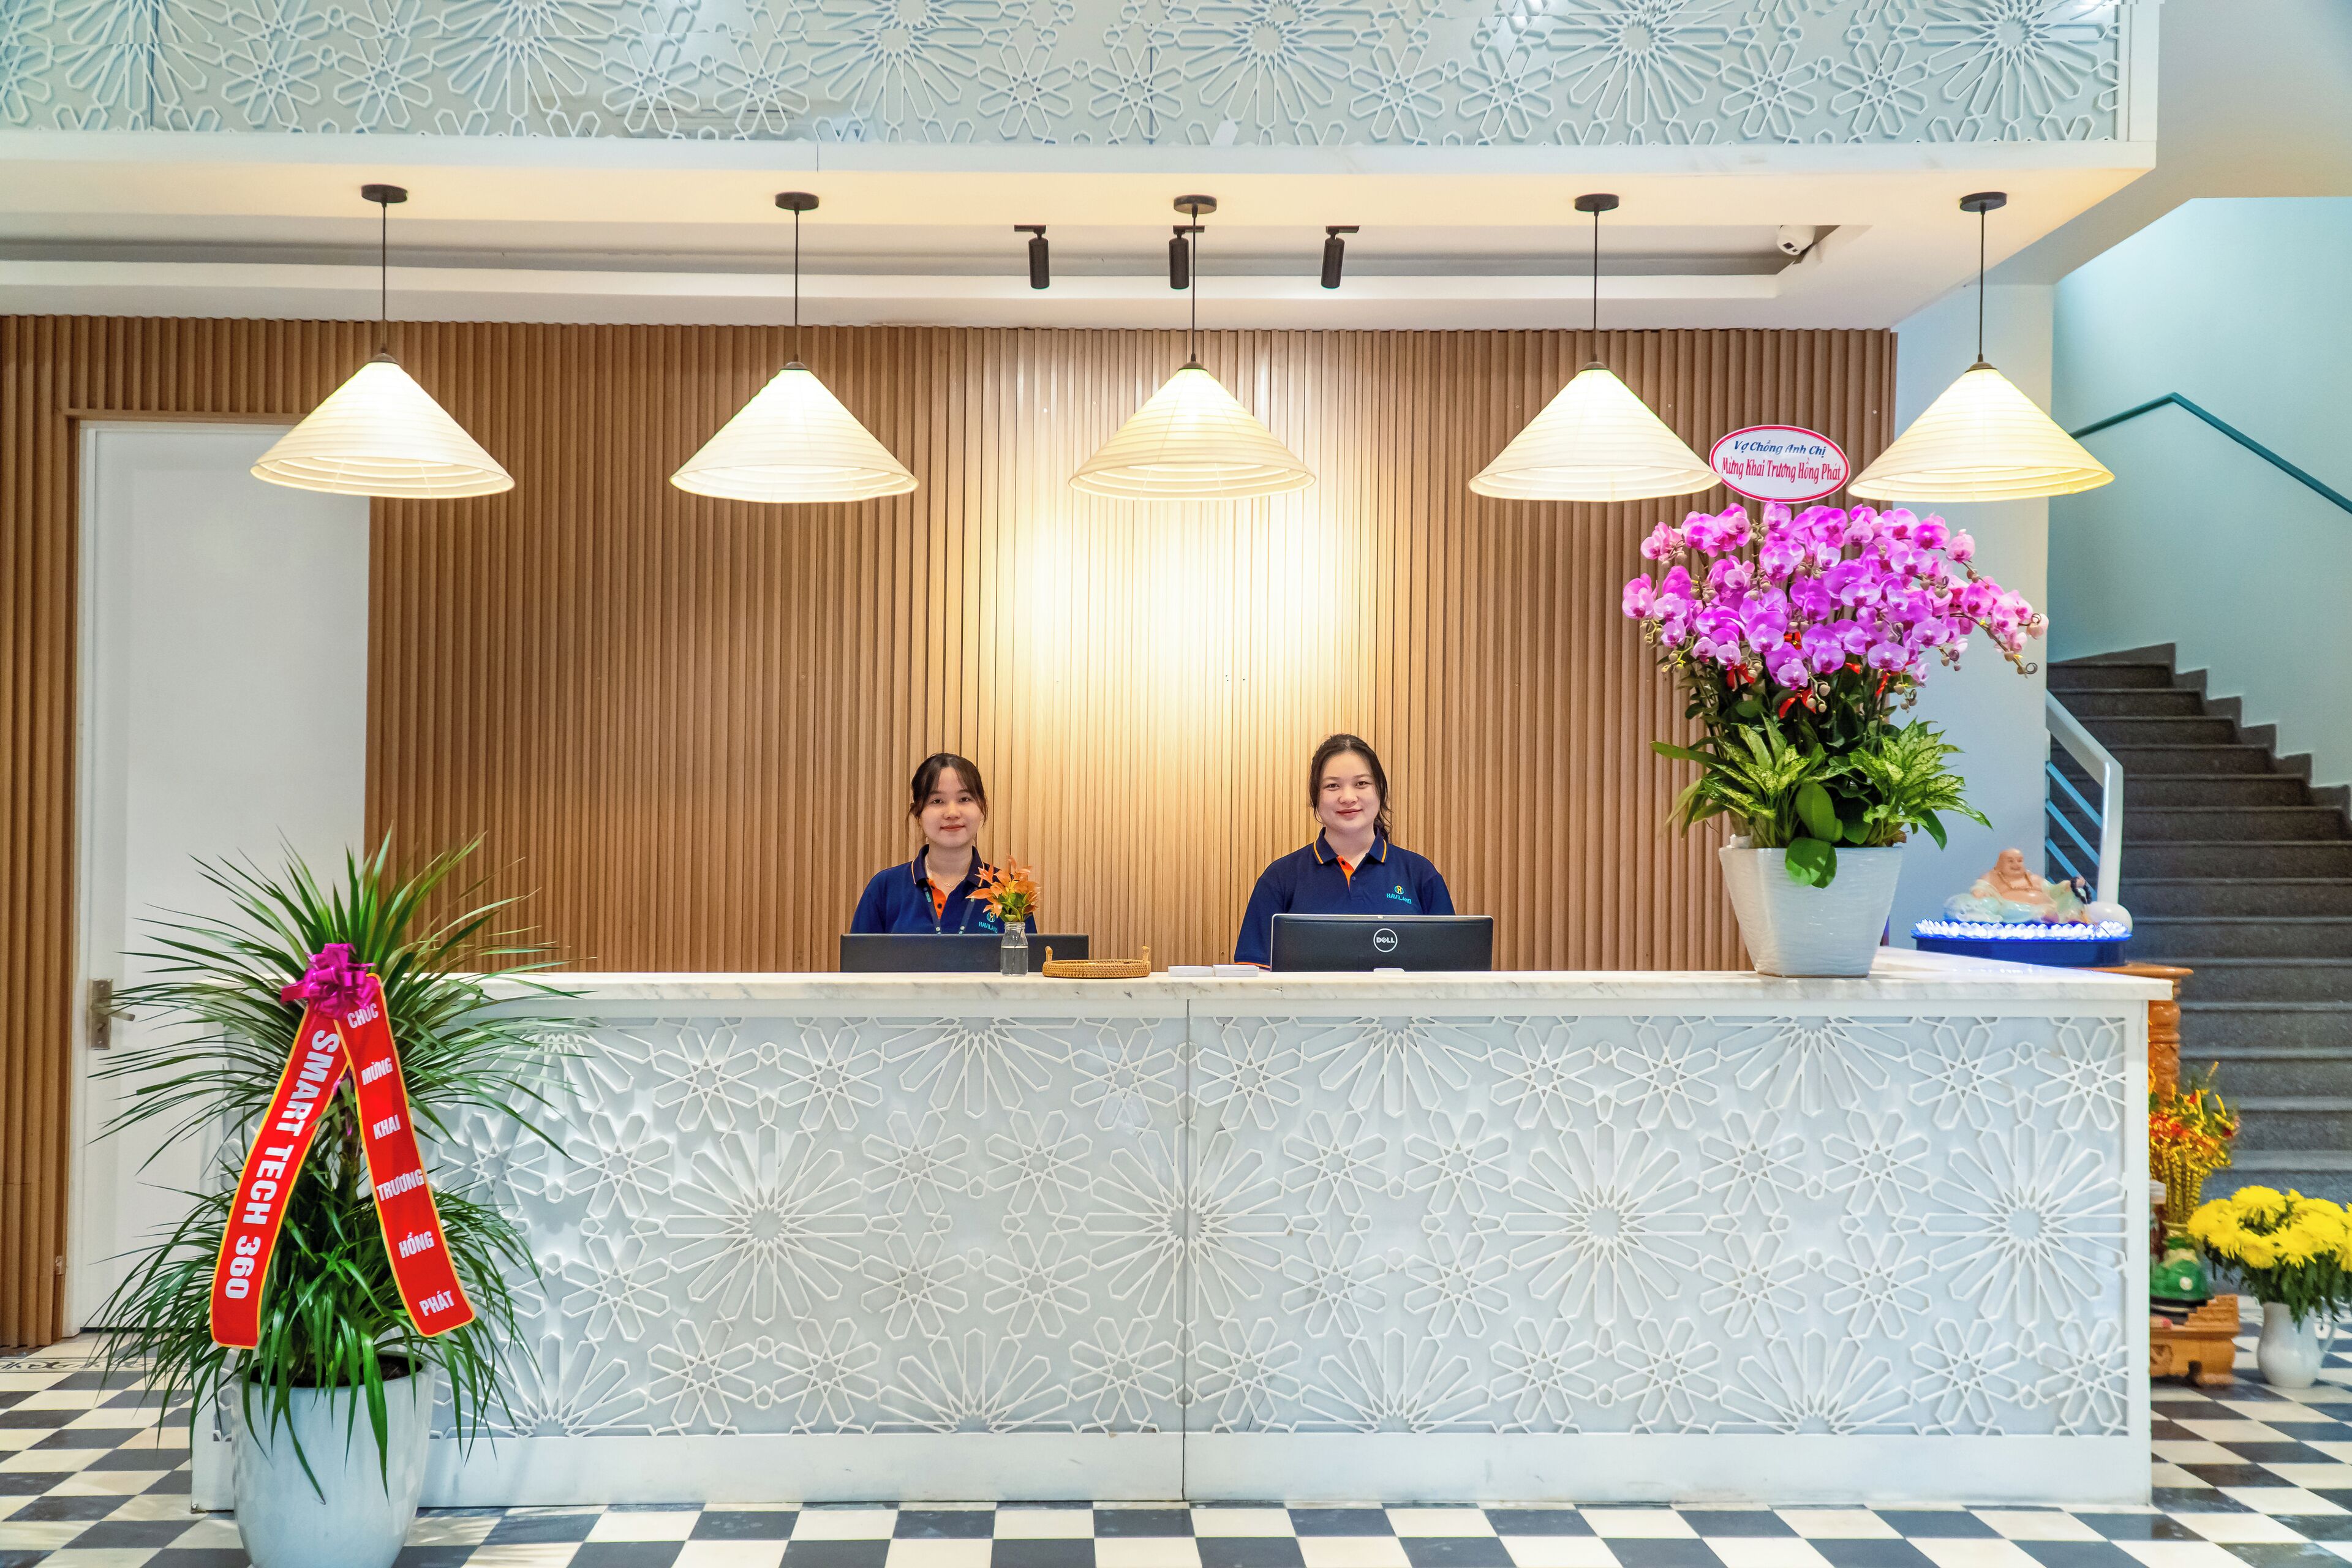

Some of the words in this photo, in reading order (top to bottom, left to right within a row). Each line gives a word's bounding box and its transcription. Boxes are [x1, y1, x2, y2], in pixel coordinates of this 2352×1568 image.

[1735, 440, 1749, 453] Vợ
[1750, 439, 1784, 455] Chồng
[1785, 444, 1806, 454] Anh
[1809, 445, 1826, 458] Chị
[1722, 456, 1744, 480] Mừng
[1746, 458, 1765, 477] Khai
[1767, 459, 1796, 483] Trương
[1798, 457, 1820, 484] Hồng
[1821, 462, 1841, 480] Phát
[275, 1030, 341, 1137] SMART
[372, 1114, 401, 1140] KHAI
[242, 1145, 295, 1225] TECH
[375, 1168, 425, 1202] TRƯƠNG
[225, 1235, 262, 1299] 360
[418, 1290, 455, 1317] PHÁT
